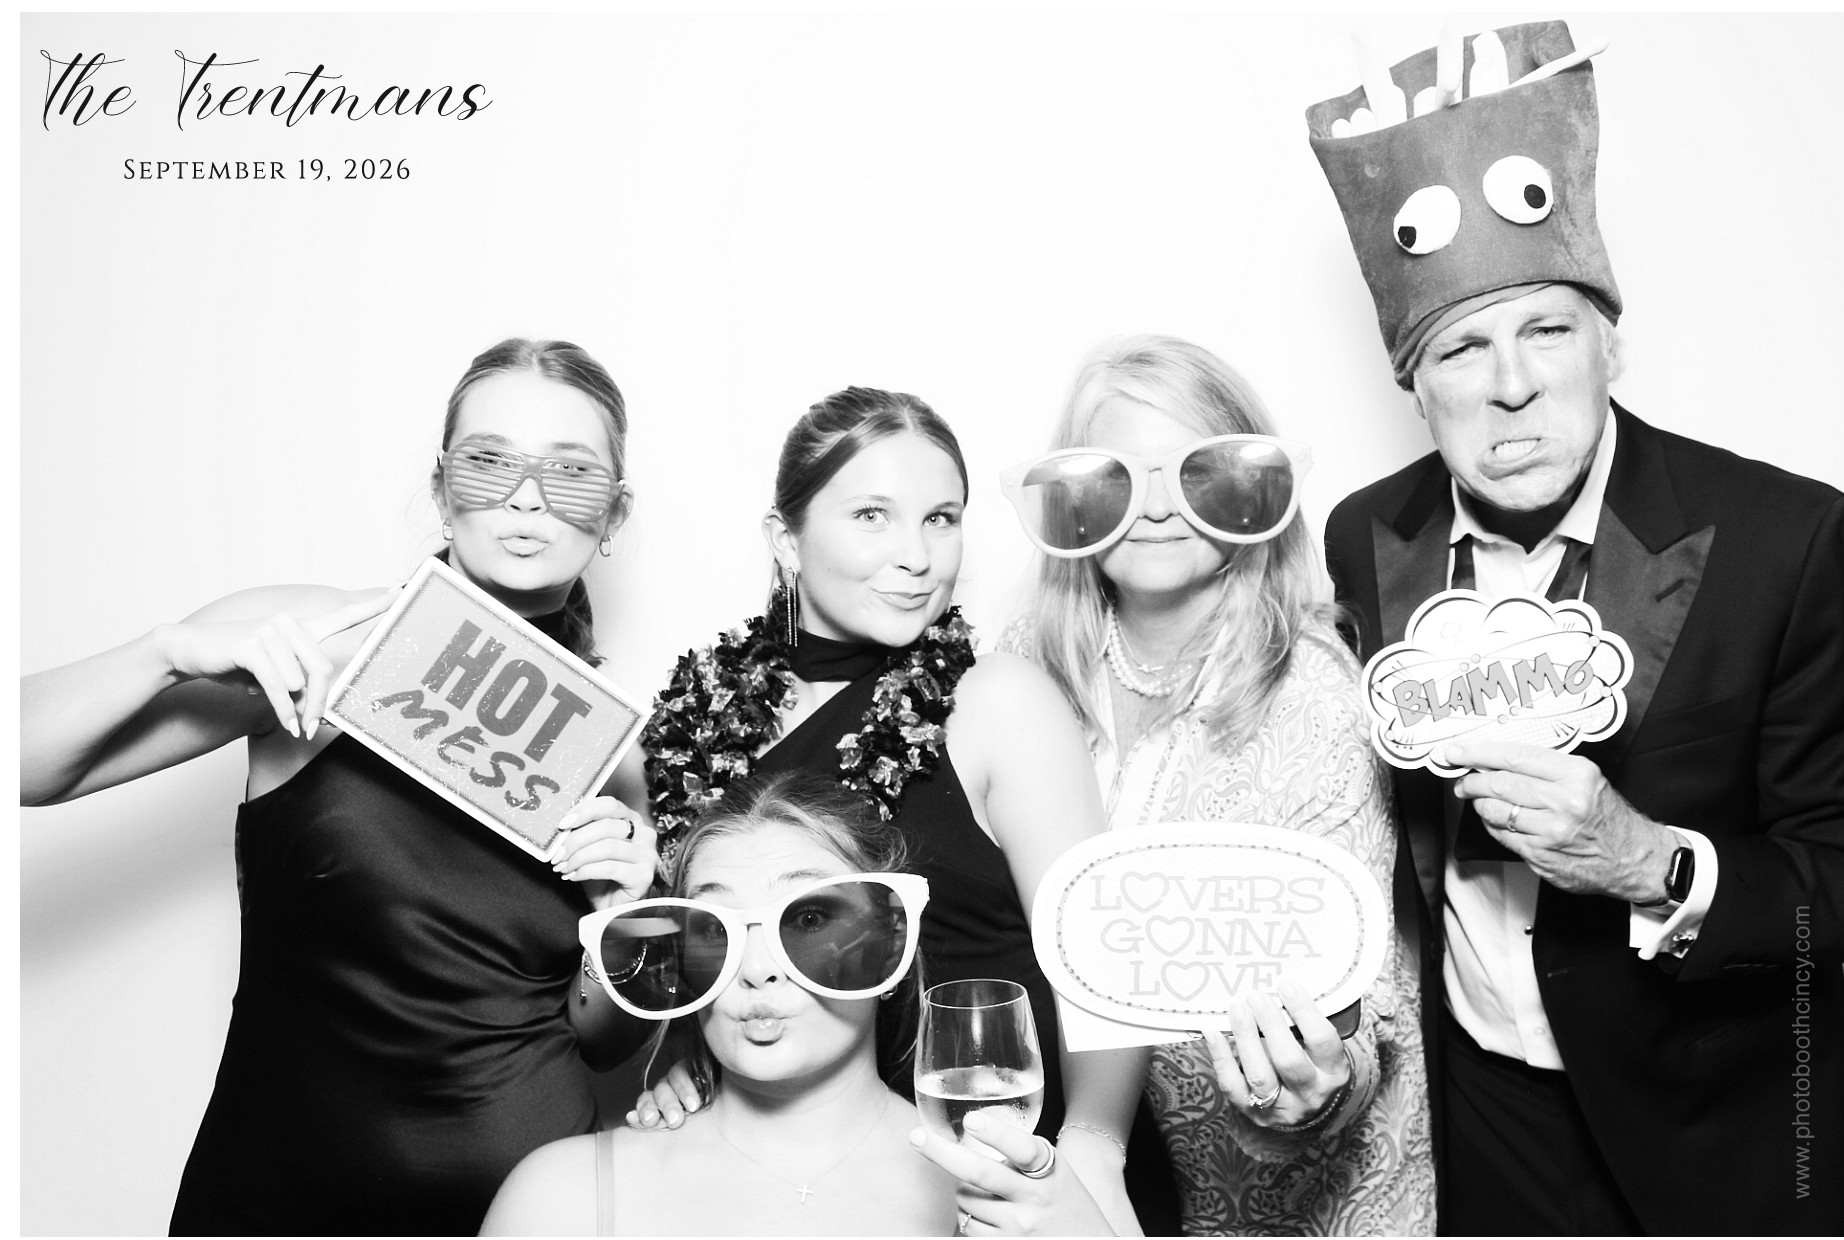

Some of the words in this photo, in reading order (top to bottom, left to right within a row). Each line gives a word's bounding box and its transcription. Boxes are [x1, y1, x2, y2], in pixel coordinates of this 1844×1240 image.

[371, 689, 561, 811] MESS
[420, 619, 593, 763] HOT
[1393, 652, 1594, 728] BLAMMO
